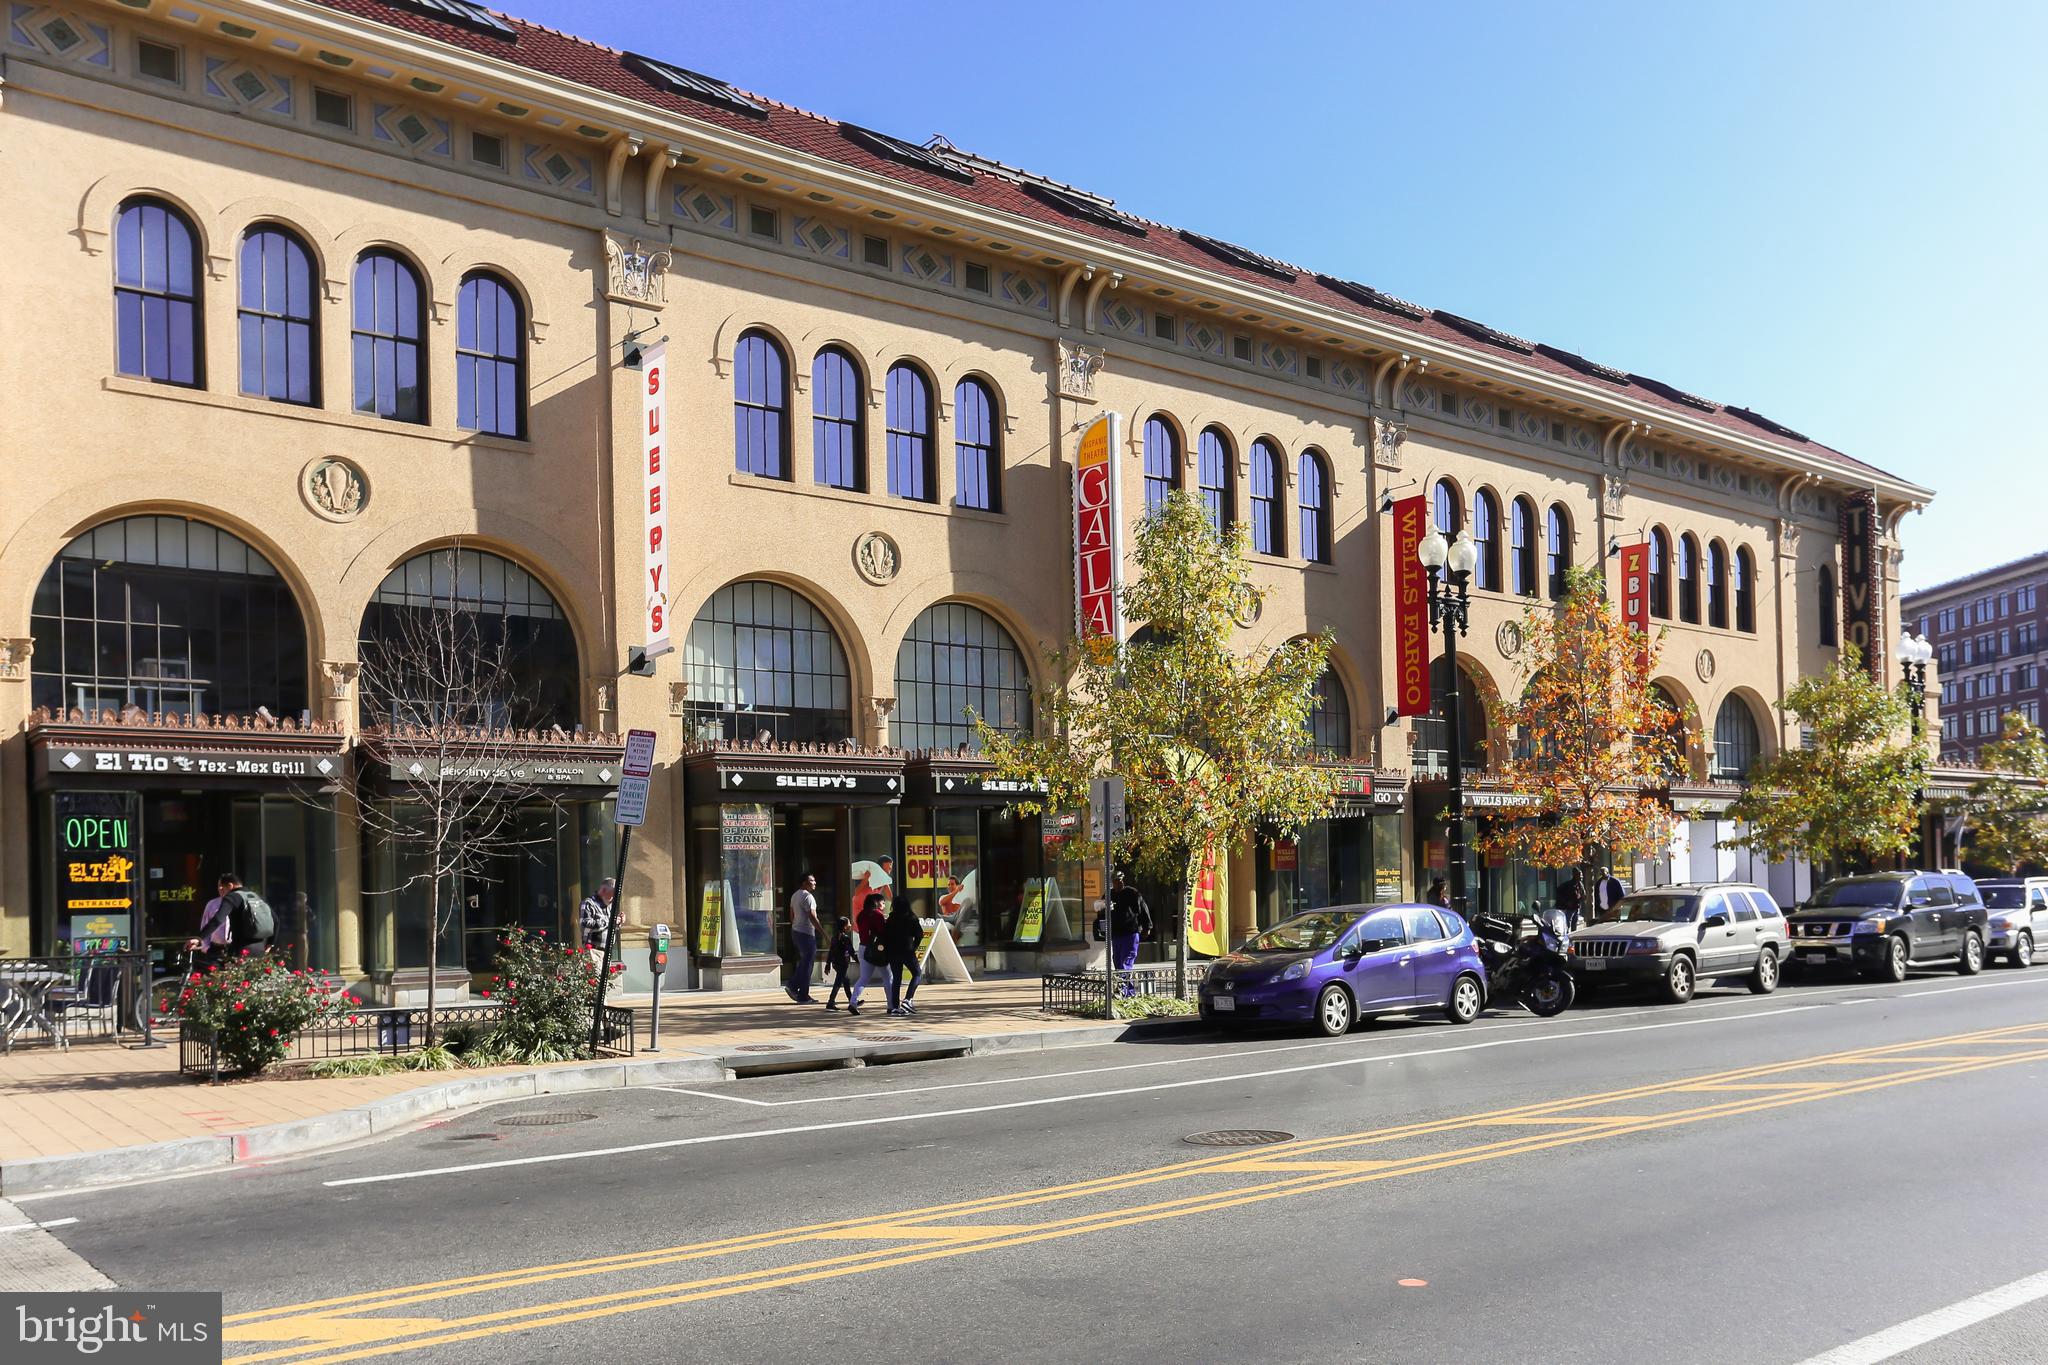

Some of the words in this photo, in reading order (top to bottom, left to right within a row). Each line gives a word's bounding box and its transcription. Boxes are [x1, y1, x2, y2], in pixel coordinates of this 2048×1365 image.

[1083, 436, 1107, 449] HISPANIC
[1079, 466, 1112, 634] GALA
[1401, 507, 1418, 605] WELLS
[1403, 612, 1421, 705] FARGO
[96, 753, 122, 770] El
[128, 754, 169, 771] Tio
[198, 760, 268, 773] Tex-Mex
[272, 762, 305, 774] Grill
[776, 774, 856, 788] SLEEPY'S
[622, 791, 644, 799] PARKING
[1472, 796, 1501, 806] WELLS
[67, 819, 127, 848] OPEN
[723, 835, 770, 843] BRAND
[907, 845, 949, 855] SLEEPY'S
[69, 863, 86, 876] El
[90, 863, 116, 876] Tio
[908, 859, 949, 879] OPEN
